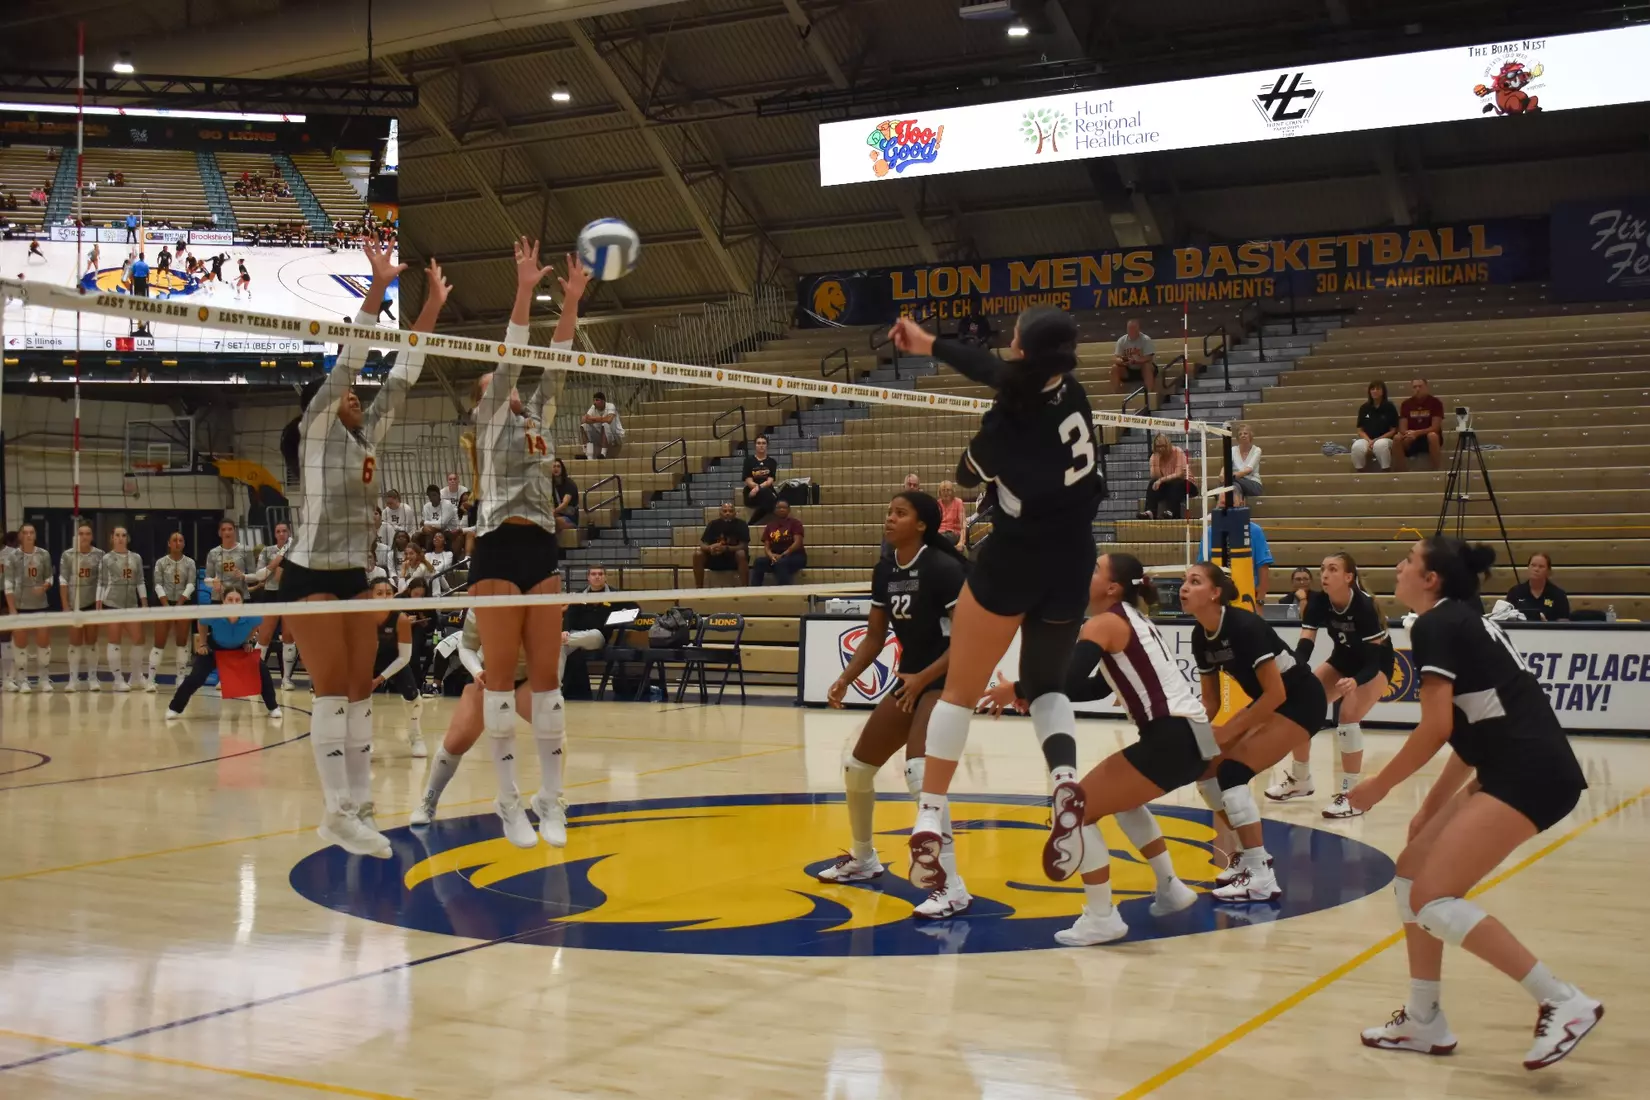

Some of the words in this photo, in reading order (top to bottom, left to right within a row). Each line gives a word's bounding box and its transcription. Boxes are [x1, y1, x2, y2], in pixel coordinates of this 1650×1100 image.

[1468, 47, 1488, 57] THE
[1492, 44, 1519, 54] BOARS
[1523, 40, 1546, 51] NEST
[1075, 100, 1114, 116] Hunt
[1075, 111, 1141, 136] Regional
[895, 119, 936, 146] Too
[1076, 130, 1160, 150] Healthcare
[190, 232, 232, 242] Brookshire's
[1590, 210, 1646, 250] Fix
[890, 264, 990, 300] LION
[1008, 251, 1155, 291] MEN'S
[1173, 224, 1502, 279] BASKETBALL
[1604, 242, 1650, 283] Fe
[952, 292, 1071, 318] CHMPIONSHIPS
[1093, 289, 1102, 307] 7
[1107, 286, 1150, 308] NCAA
[1155, 276, 1274, 305] TOURNAMENTS
[1344, 263, 1488, 290] ALL-AMERICANS
[97, 295, 125, 307] EAST
[128, 299, 163, 313] TEXAS
[219, 312, 244, 323] EAST
[248, 316, 278, 330] TEXAS
[328, 325, 351, 337] EAST
[354, 328, 381, 340] TEXAS
[27, 337, 32, 345] S
[35, 337, 62, 346] Illinois
[105, 340, 112, 348] 6
[137, 339, 154, 347] ULM
[214, 341, 221, 349] 7
[227, 342, 242, 350] SET
[253, 342, 276, 351] (BEST
[279, 342, 290, 350] OF
[426, 337, 445, 348] EAST
[448, 339, 472, 351] TEXAS
[512, 348, 531, 358] EAST
[533, 350, 555, 361] TEXAS
[591, 358, 608, 367] EAST
[610, 360, 630, 369] TEXAS
[663, 366, 678, 375] EAST
[680, 368, 697, 377] TEXAS
[727, 373, 742, 381] EAST
[743, 375, 760, 384] TEXAS
[526, 433, 547, 456] 14
[1058, 411, 1094, 486] 3
[363, 457, 375, 484] 6
[28, 567, 37, 577] 10
[79, 568, 91, 578] 20
[123, 568, 132, 578] 12
[223, 562, 235, 572] 22
[174, 574, 180, 584] 5
[891, 594, 912, 619] 22
[634, 618, 656, 626] IONS
[709, 618, 737, 626] LIONS
[1519, 652, 1562, 680] ST
